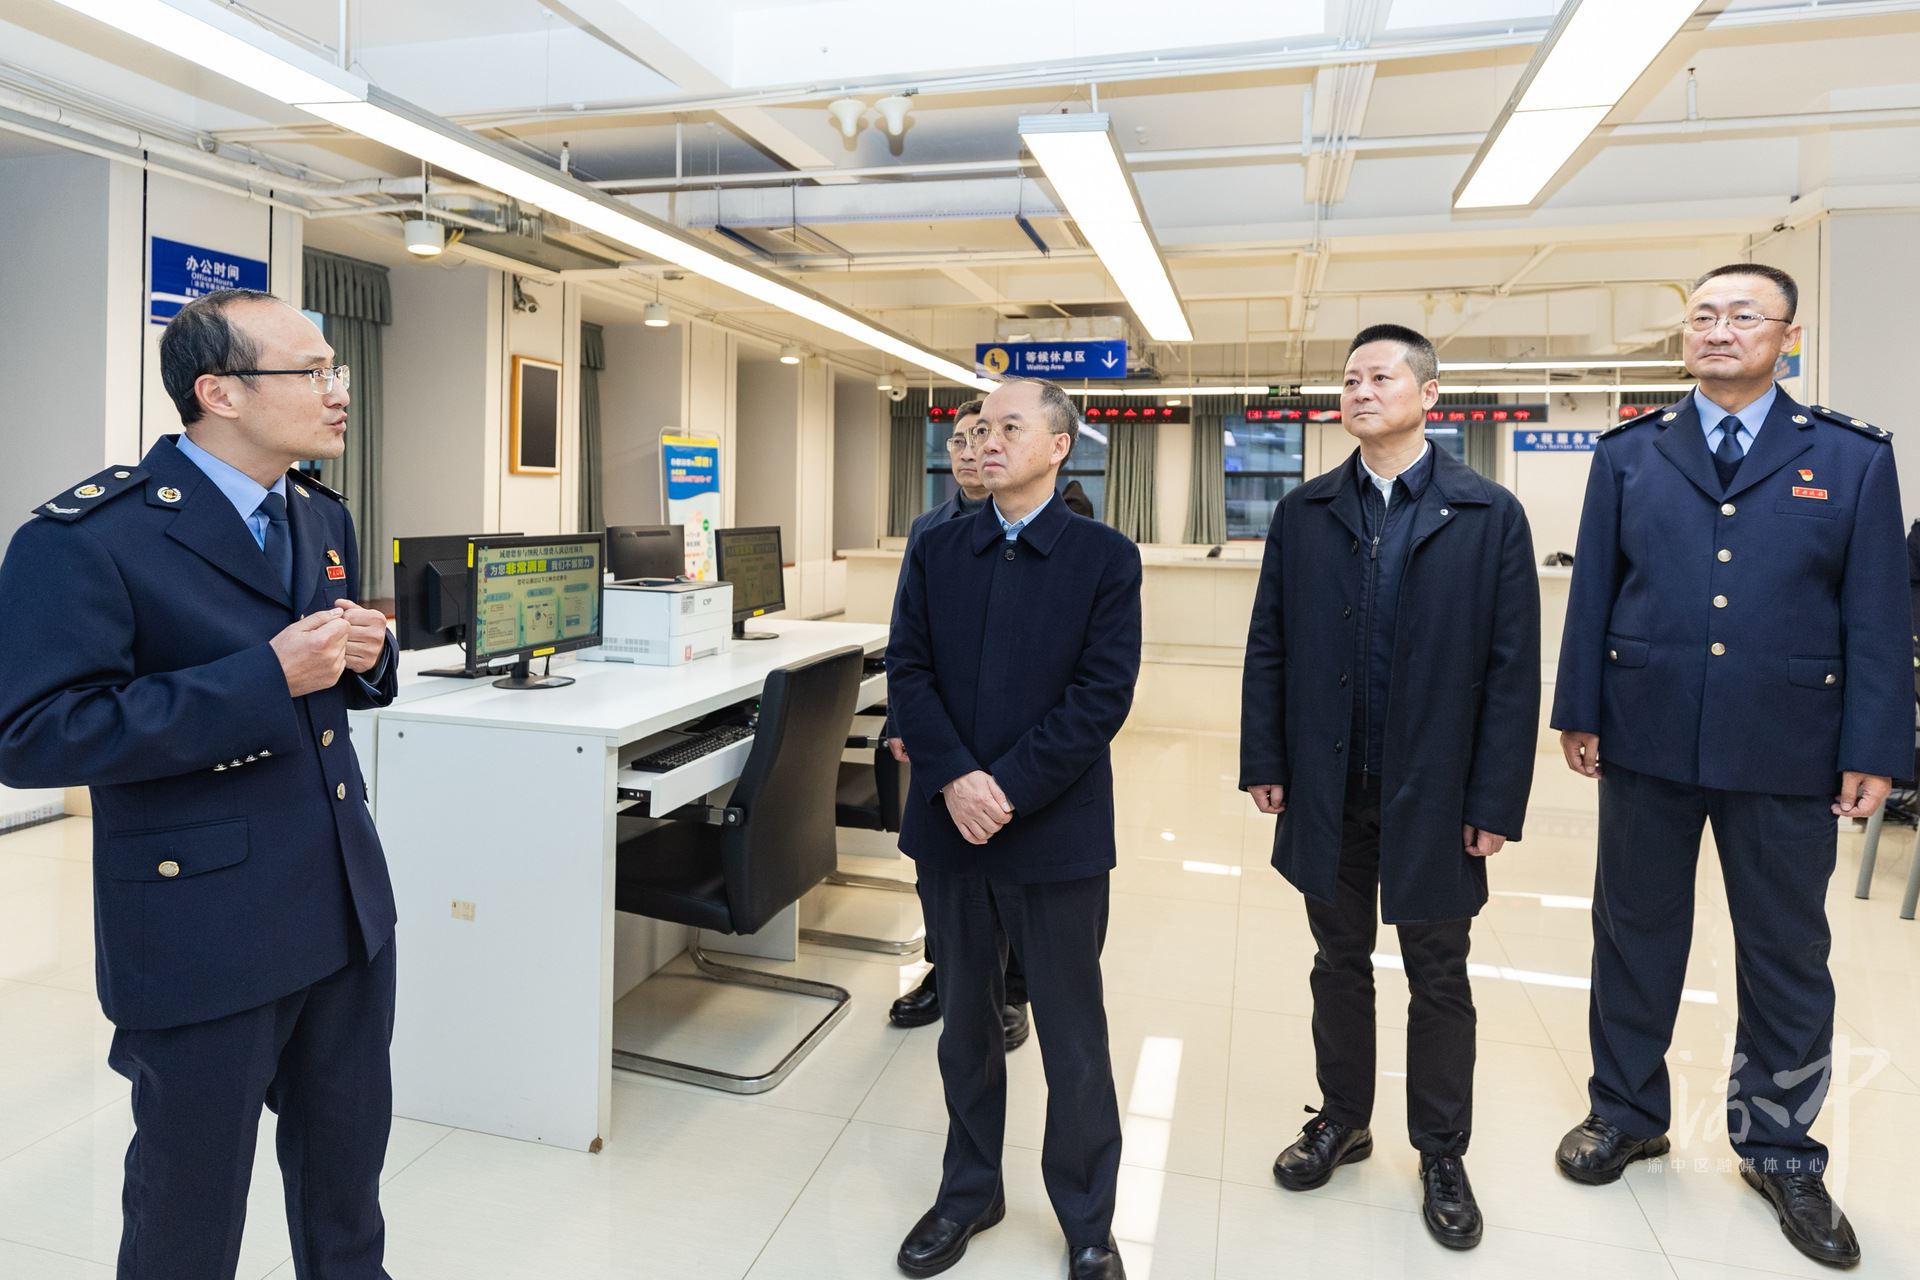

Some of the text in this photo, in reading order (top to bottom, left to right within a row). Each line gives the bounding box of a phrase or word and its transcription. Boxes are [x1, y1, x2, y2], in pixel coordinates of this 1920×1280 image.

[186, 255, 239, 281] 办公时间
[191, 271, 234, 288] Office Hours
[1025, 350, 1086, 363] 等候休息区
[1026, 364, 1050, 372] Waiting
